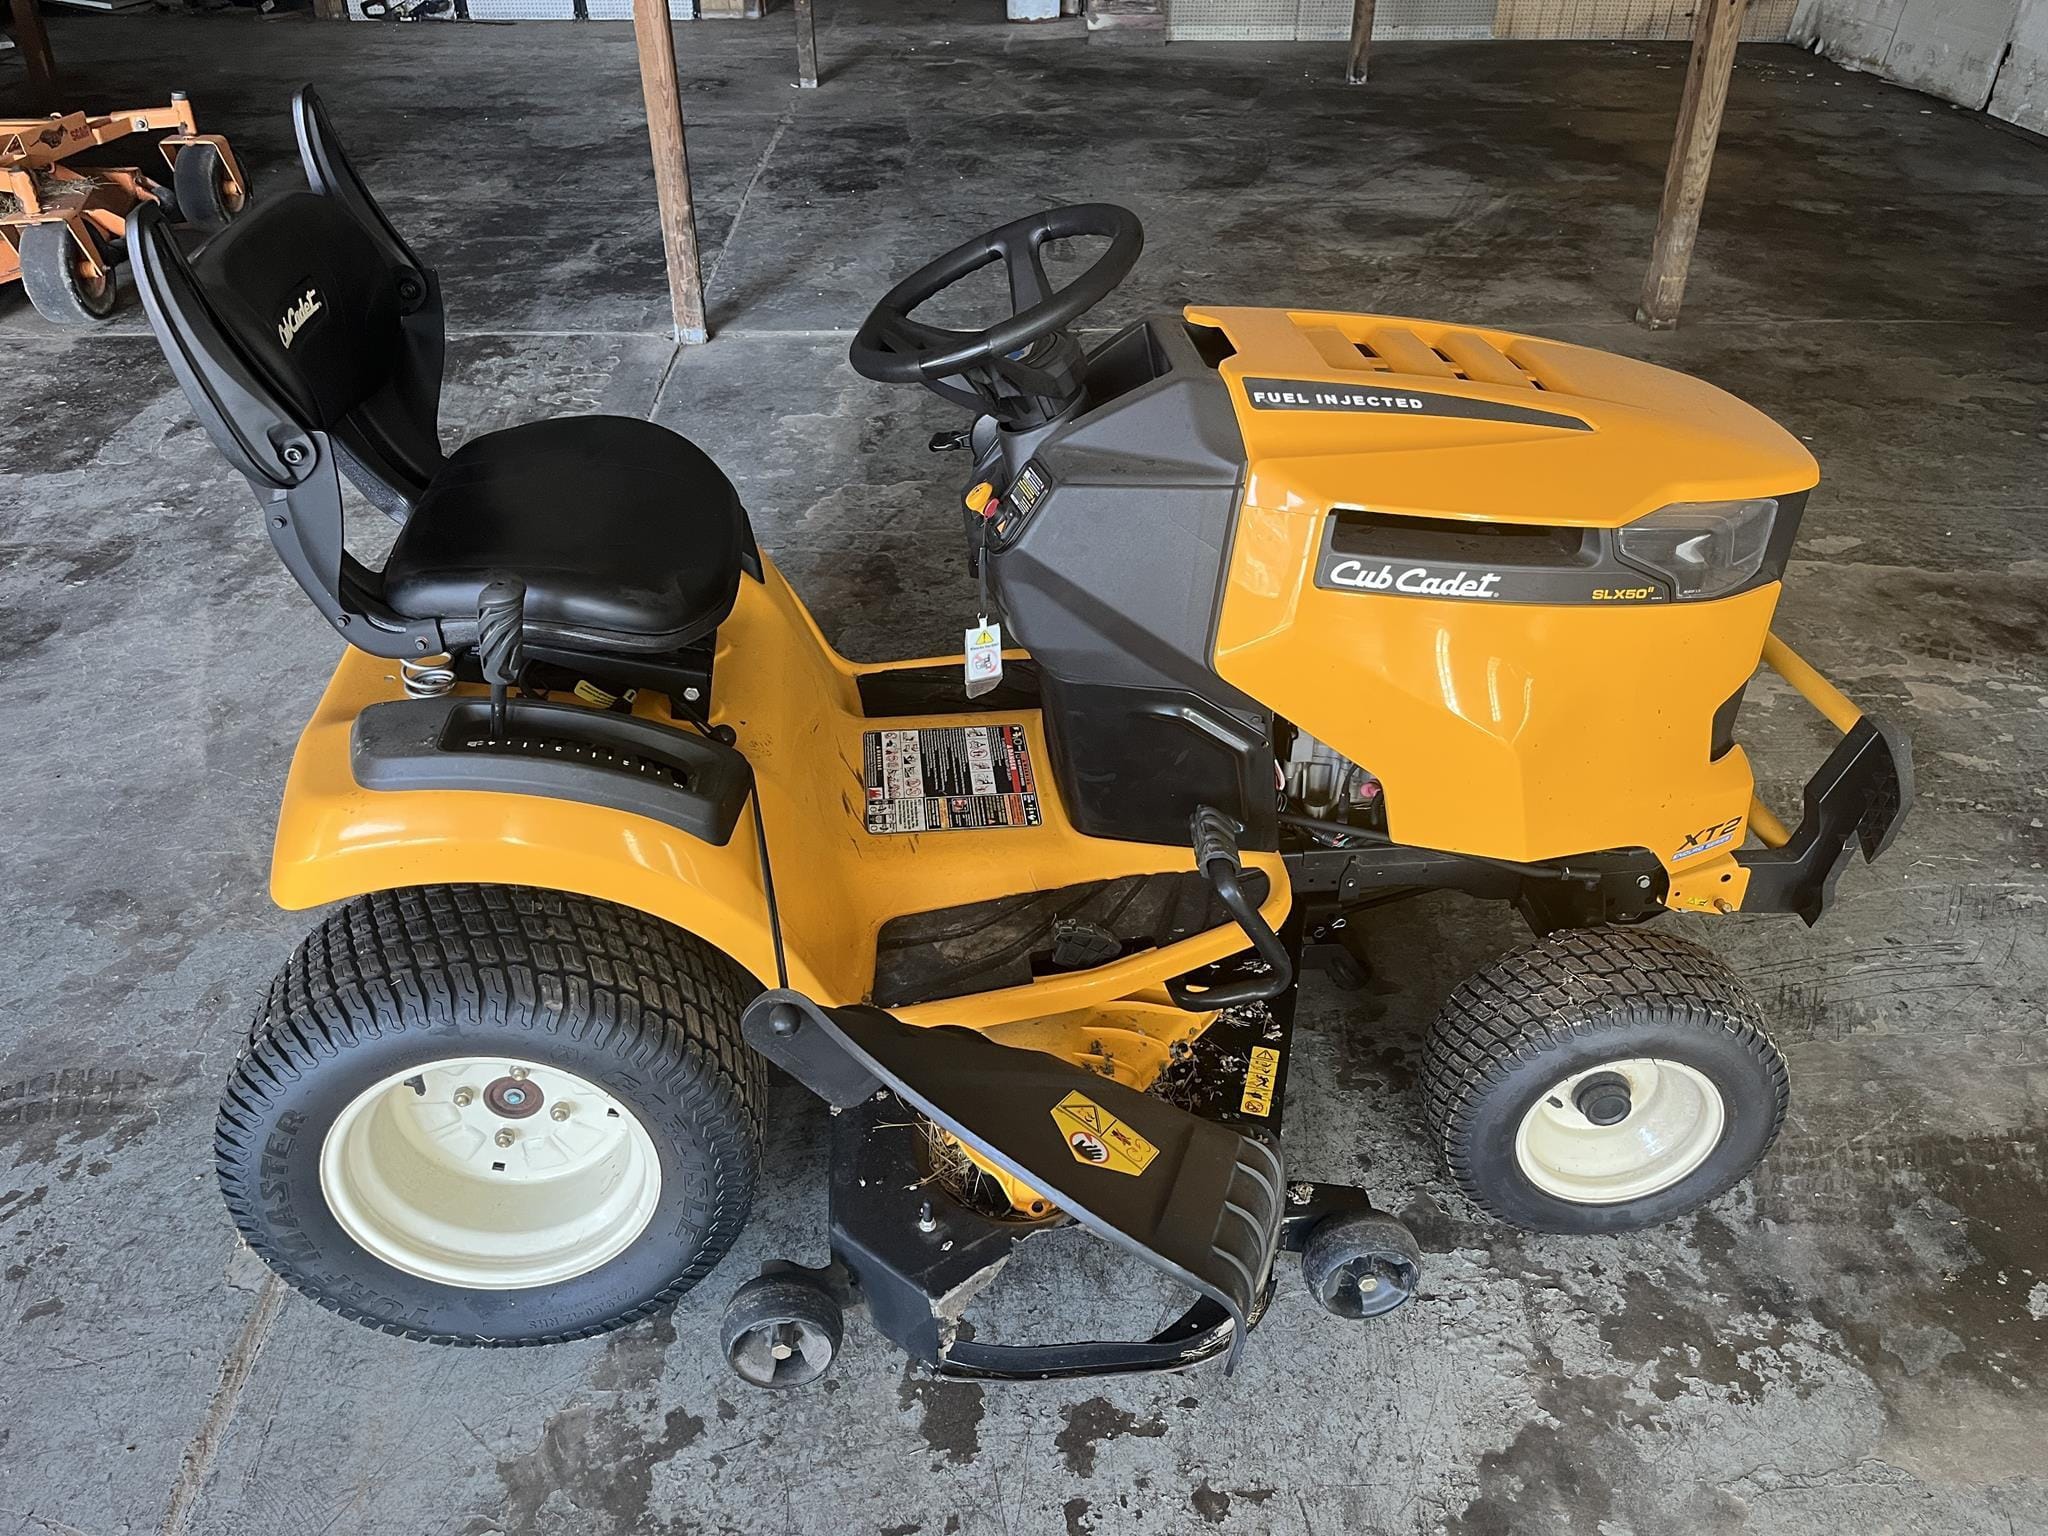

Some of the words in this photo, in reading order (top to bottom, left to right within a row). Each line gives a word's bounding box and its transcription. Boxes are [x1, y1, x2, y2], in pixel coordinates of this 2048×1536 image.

[287, 288, 322, 333] Cadet
[1253, 391, 1310, 405] FUEL
[1315, 393, 1424, 409] INJECTED
[1330, 560, 1393, 590] Cub
[1396, 571, 1501, 598] Cadet
[1591, 585, 1655, 600] SLX50"
[1676, 816, 1743, 852] XT2
[259, 1109, 322, 1262] MASTER
